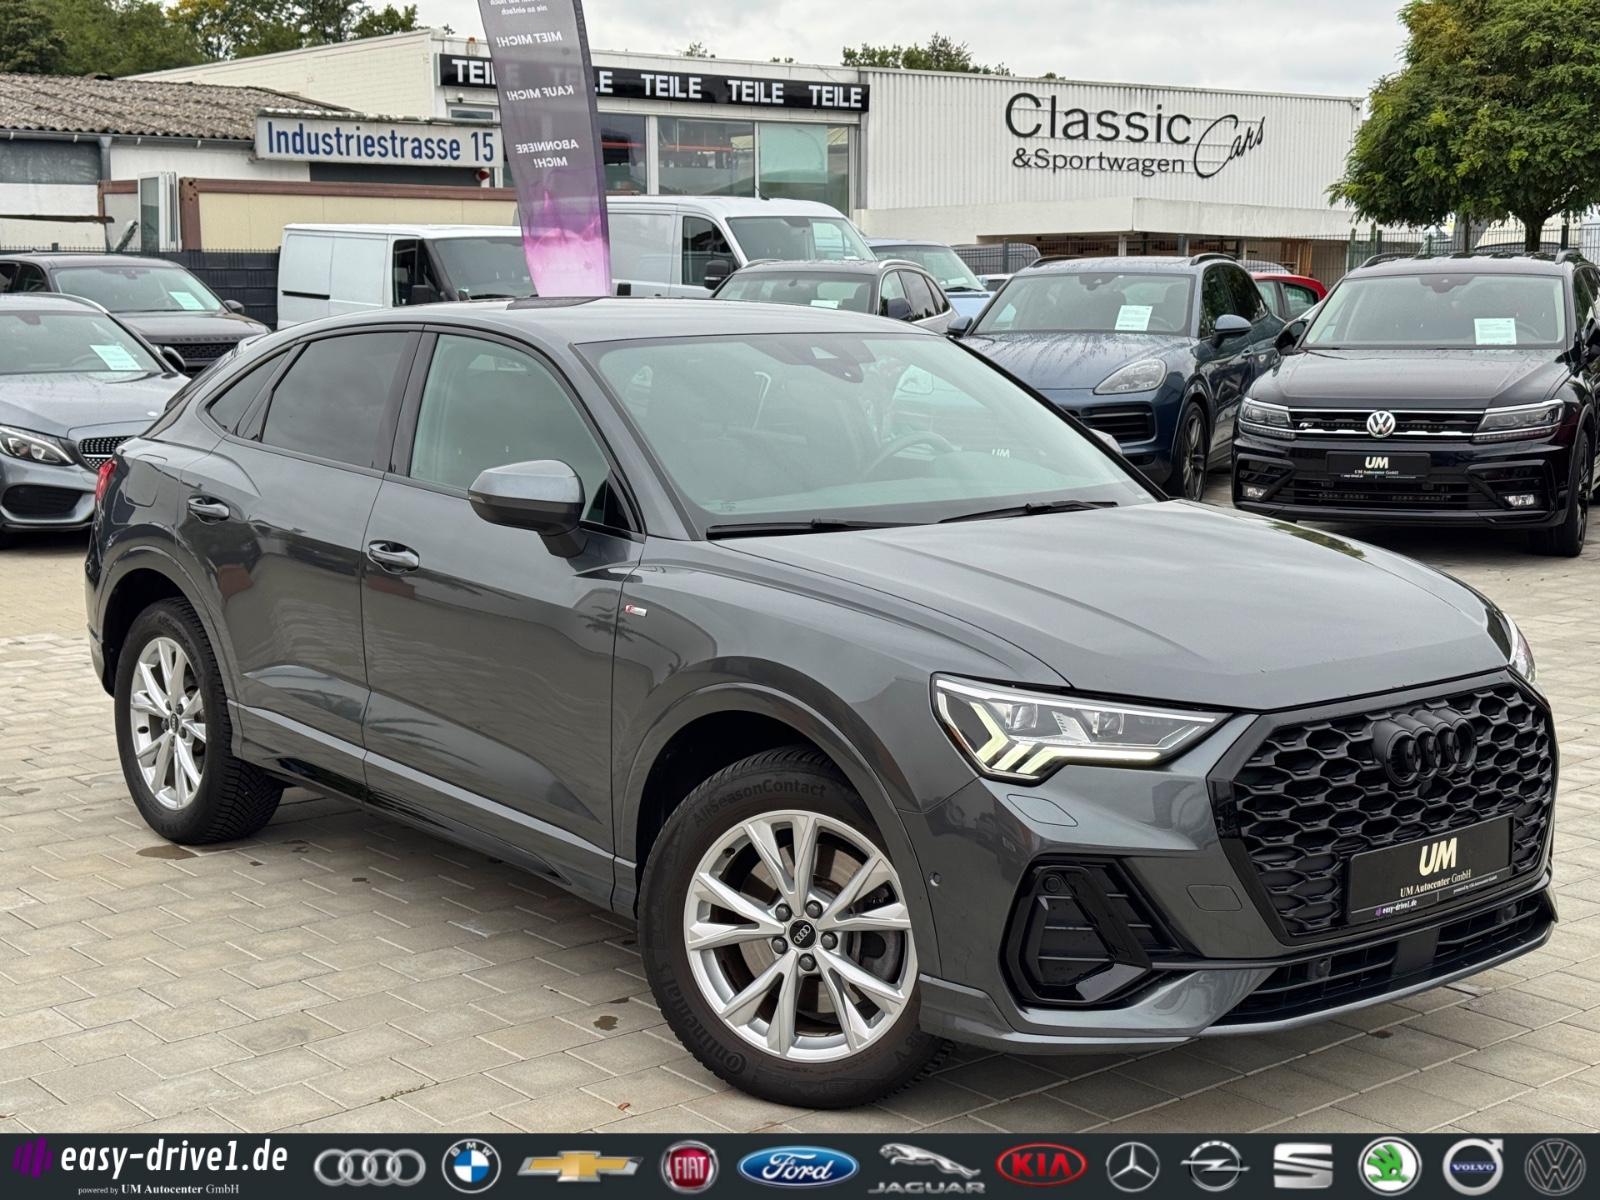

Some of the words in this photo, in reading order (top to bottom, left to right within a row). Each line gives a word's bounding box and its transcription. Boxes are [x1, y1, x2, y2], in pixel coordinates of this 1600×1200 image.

[640, 73, 702, 99] TEILE
[728, 79, 784, 104] TEILE
[808, 84, 862, 108] TEILE
[268, 121, 461, 160] Industriestrasse
[470, 131, 494, 162] 15
[1006, 92, 1192, 145] Classic
[1193, 114, 1266, 179] Cars
[1012, 147, 1185, 178] &Sportwagen
[1365, 456, 1389, 469] UM
[693, 778, 827, 828] AllSeasonContact
[1419, 837, 1458, 876] UM
[1400, 885, 1414, 898] UM
[1414, 876, 1450, 894] Autocenter
[1452, 868, 1472, 883] GmbH
